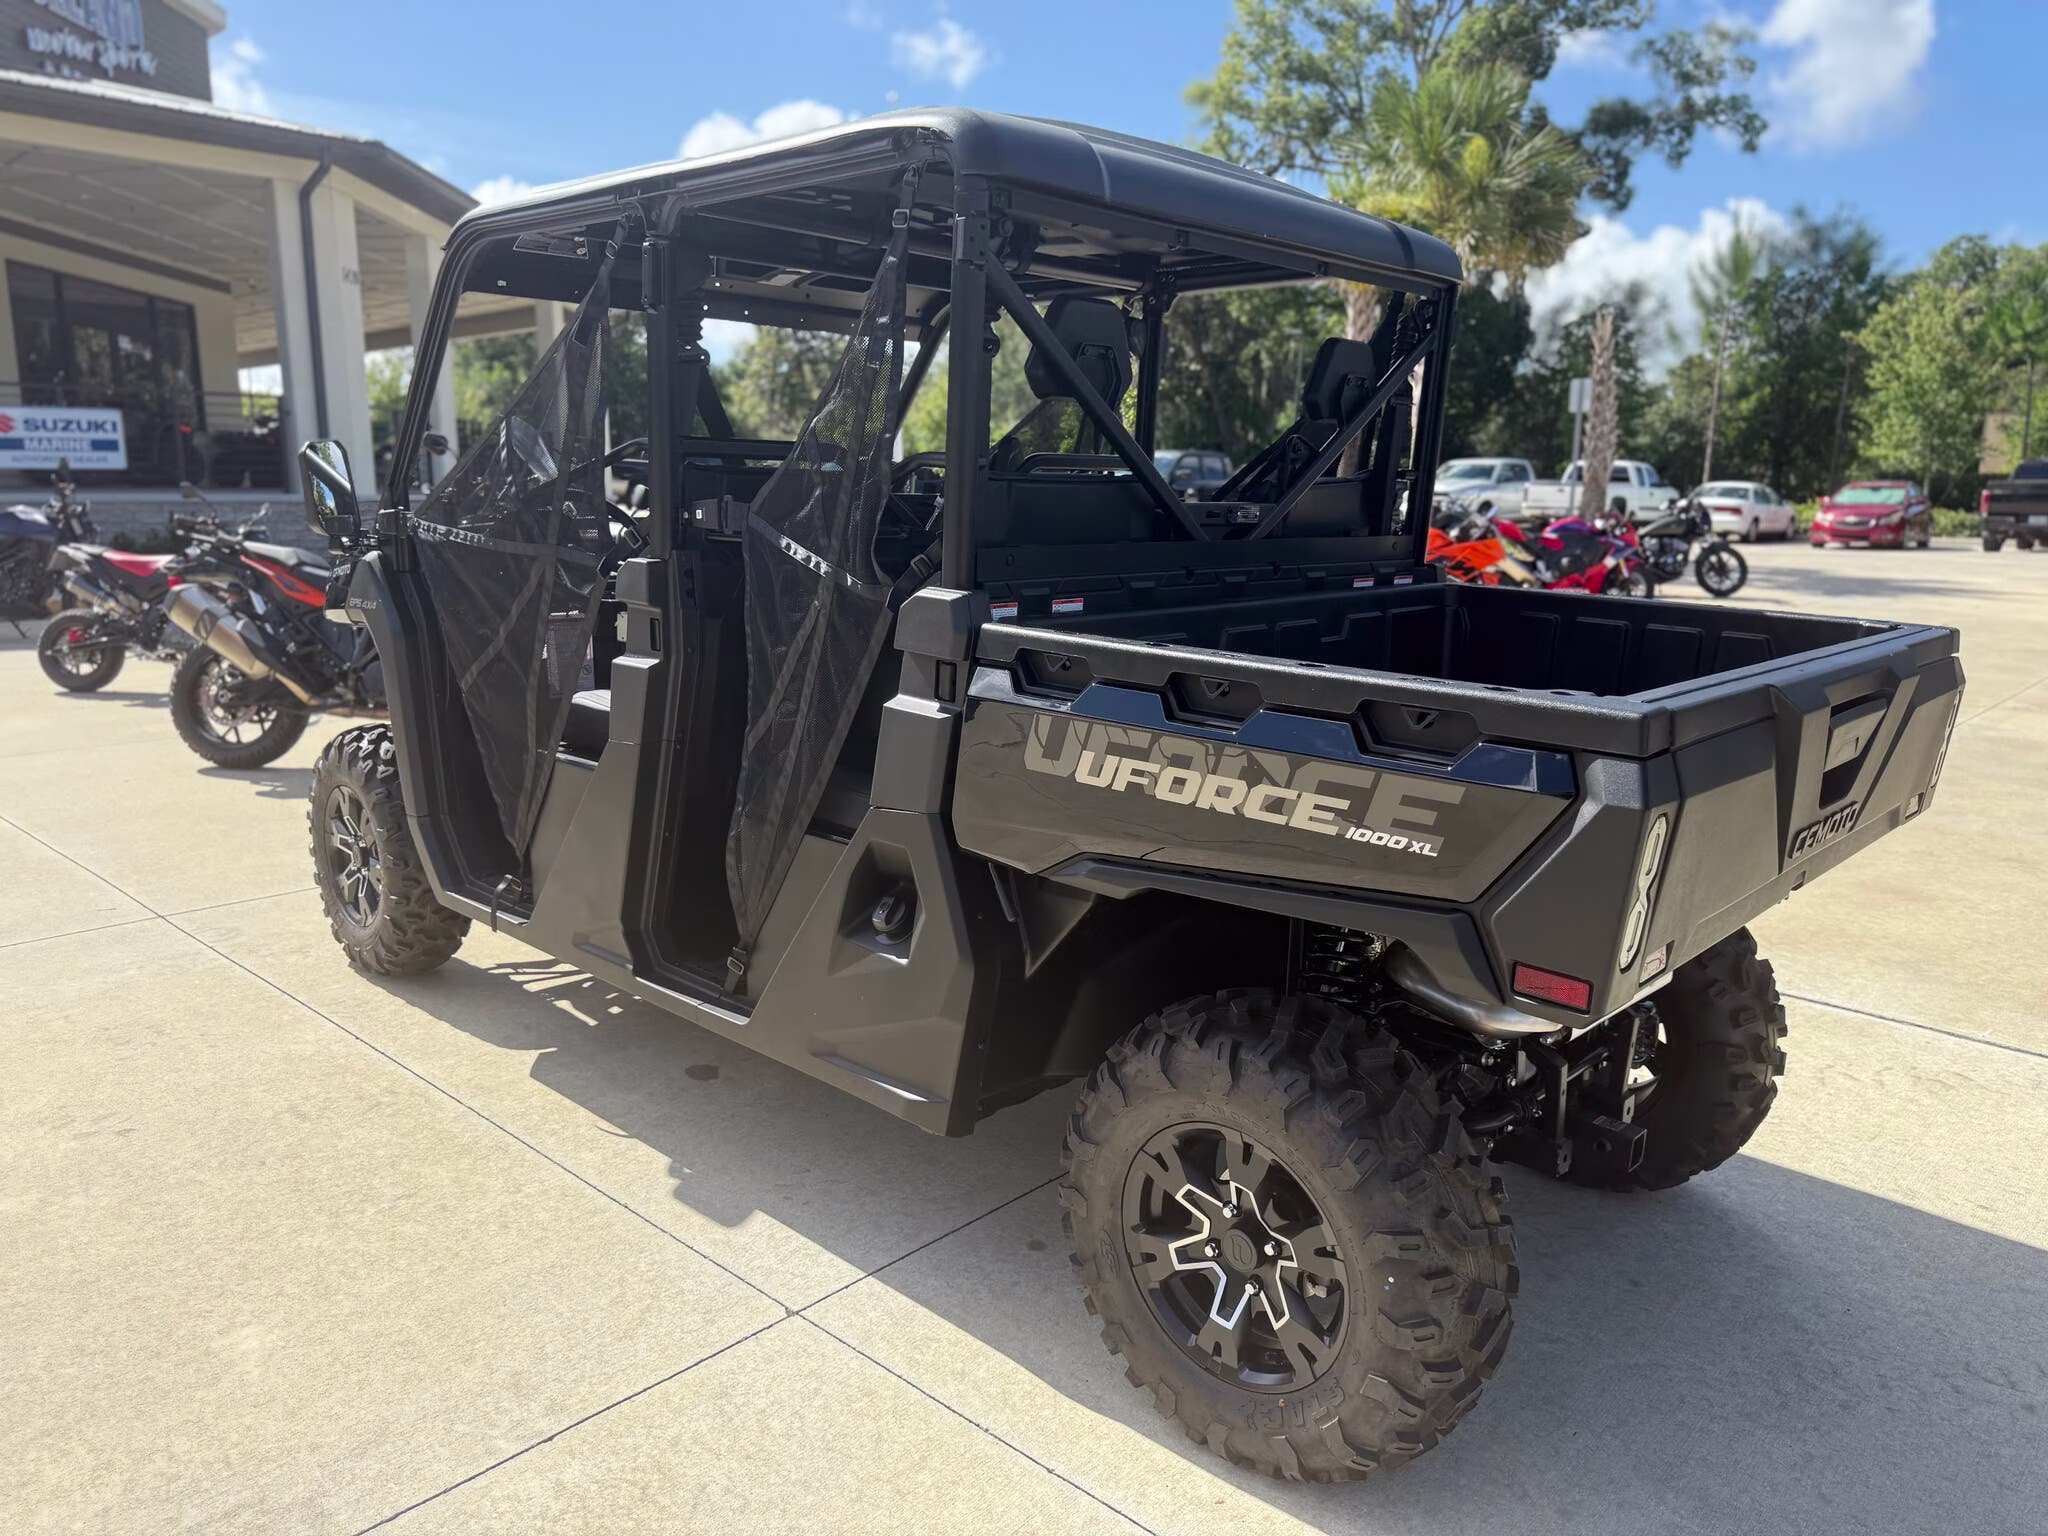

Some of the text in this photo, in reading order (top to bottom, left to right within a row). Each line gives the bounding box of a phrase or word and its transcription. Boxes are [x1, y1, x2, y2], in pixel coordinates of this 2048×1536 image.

[23, 417, 118, 433] SUZUKI
[24, 437, 91, 452] MARINE
[1075, 750, 1439, 857] UFORCE 1000 XL
[1788, 801, 1860, 860] CFMOTO
